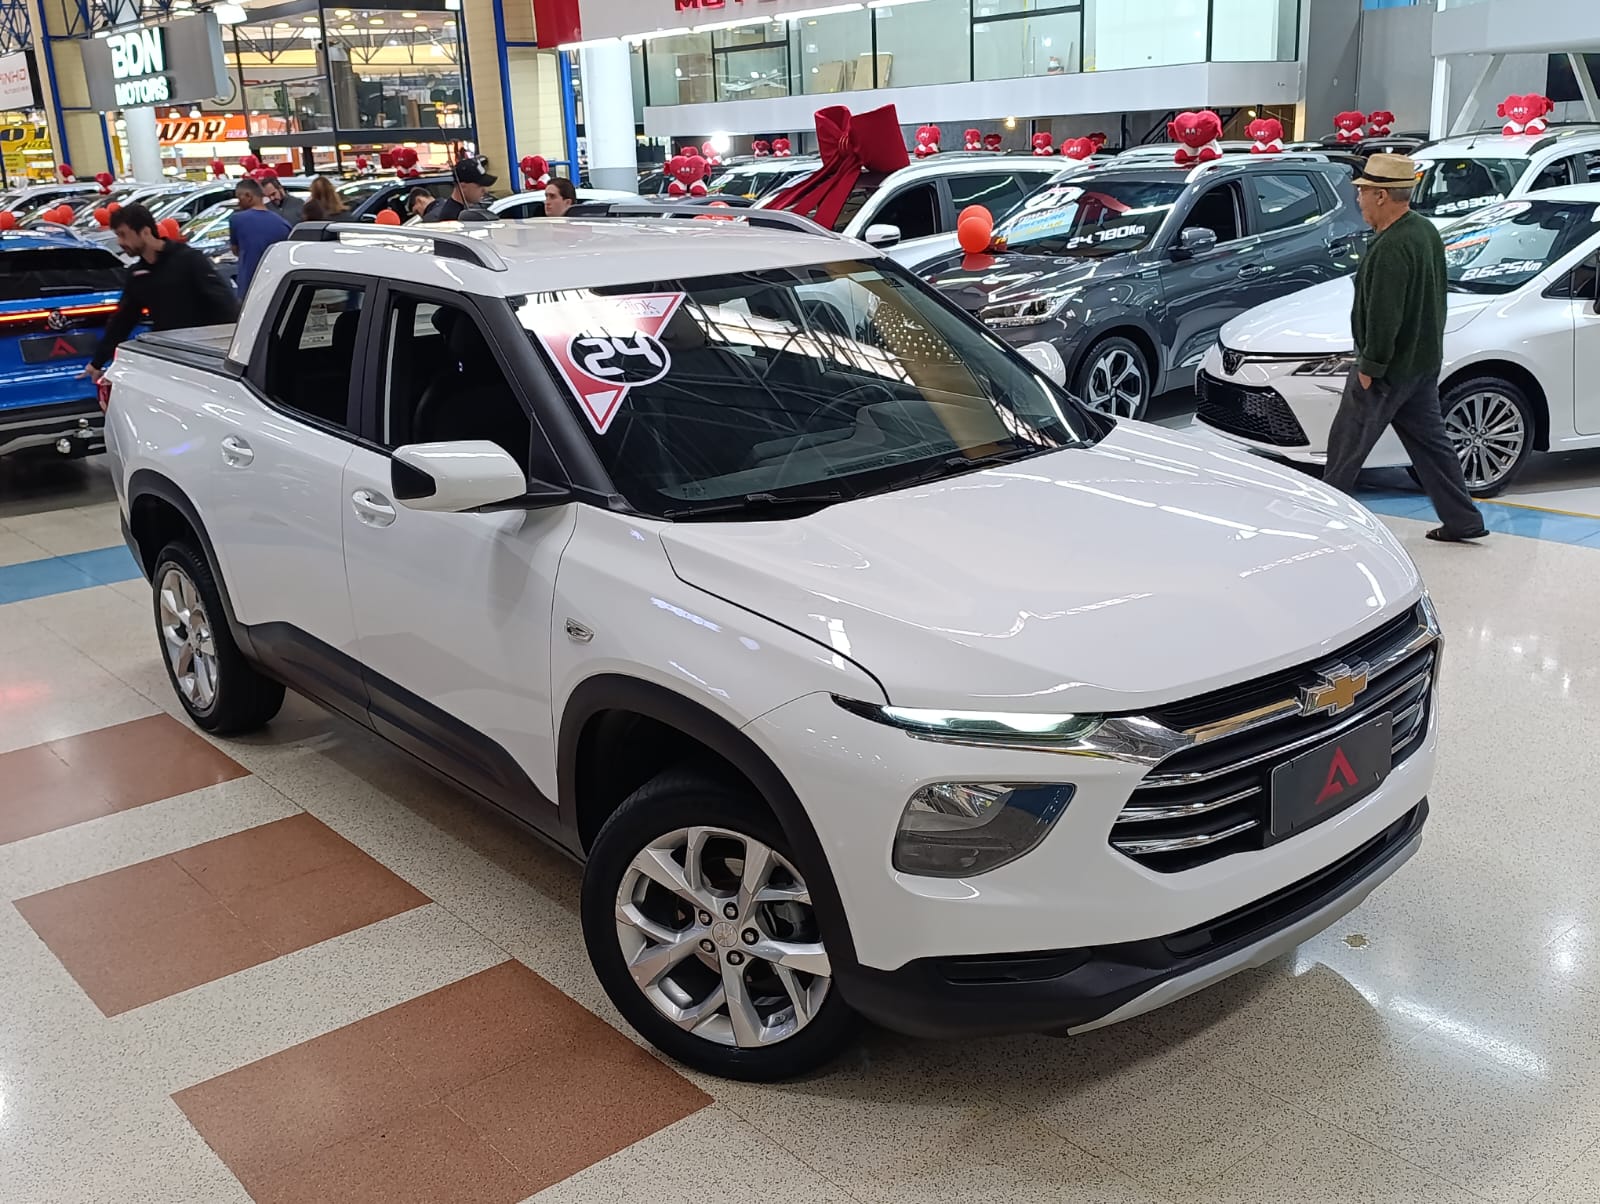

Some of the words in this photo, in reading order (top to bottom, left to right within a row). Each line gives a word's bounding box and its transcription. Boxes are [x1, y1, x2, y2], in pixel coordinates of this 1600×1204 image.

[106, 26, 164, 78] BDN
[114, 75, 169, 106] MOTORS
[577, 335, 663, 377] 24
